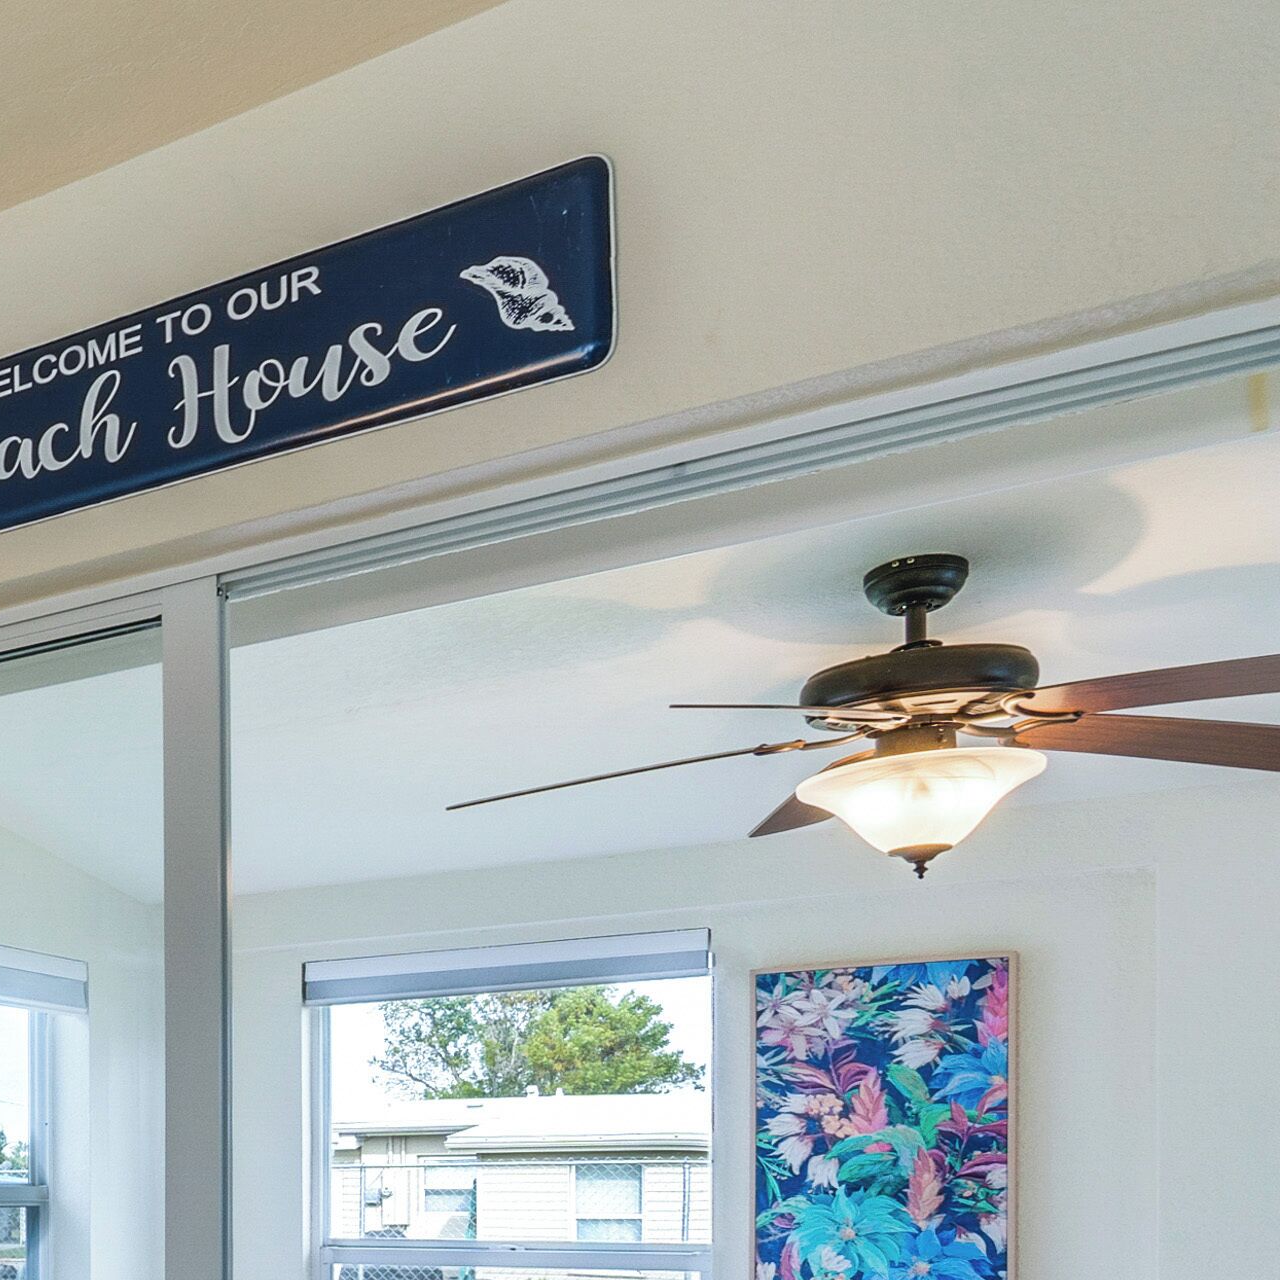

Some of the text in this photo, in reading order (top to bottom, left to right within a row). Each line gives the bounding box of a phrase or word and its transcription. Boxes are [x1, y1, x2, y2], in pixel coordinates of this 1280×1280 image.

[155, 302, 213, 345] TO
[226, 265, 323, 322] OUR
[167, 306, 458, 449] House
